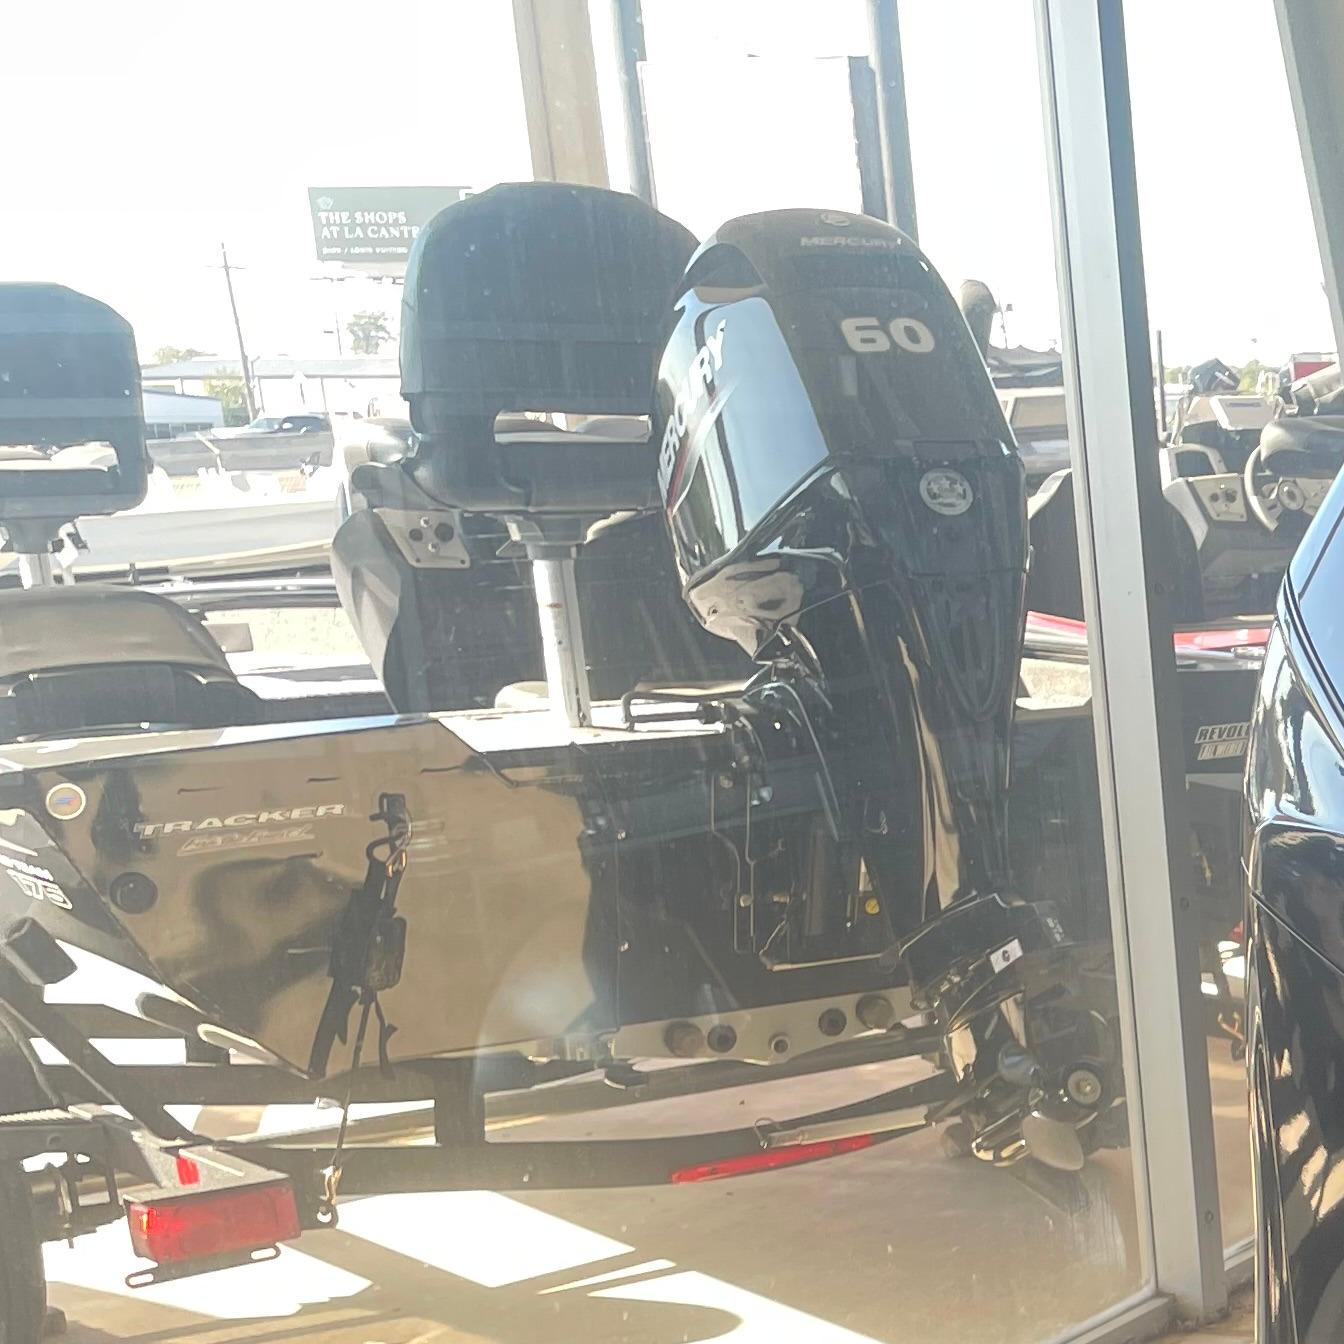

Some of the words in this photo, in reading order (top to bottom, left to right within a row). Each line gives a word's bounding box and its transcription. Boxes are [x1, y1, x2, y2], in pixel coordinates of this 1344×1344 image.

[317, 210, 352, 225] THE
[354, 210, 407, 225] SHOPS
[321, 226, 340, 240] AT
[343, 226, 364, 239] LA
[840, 316, 935, 353] 60
[132, 803, 345, 839] TRACKER
